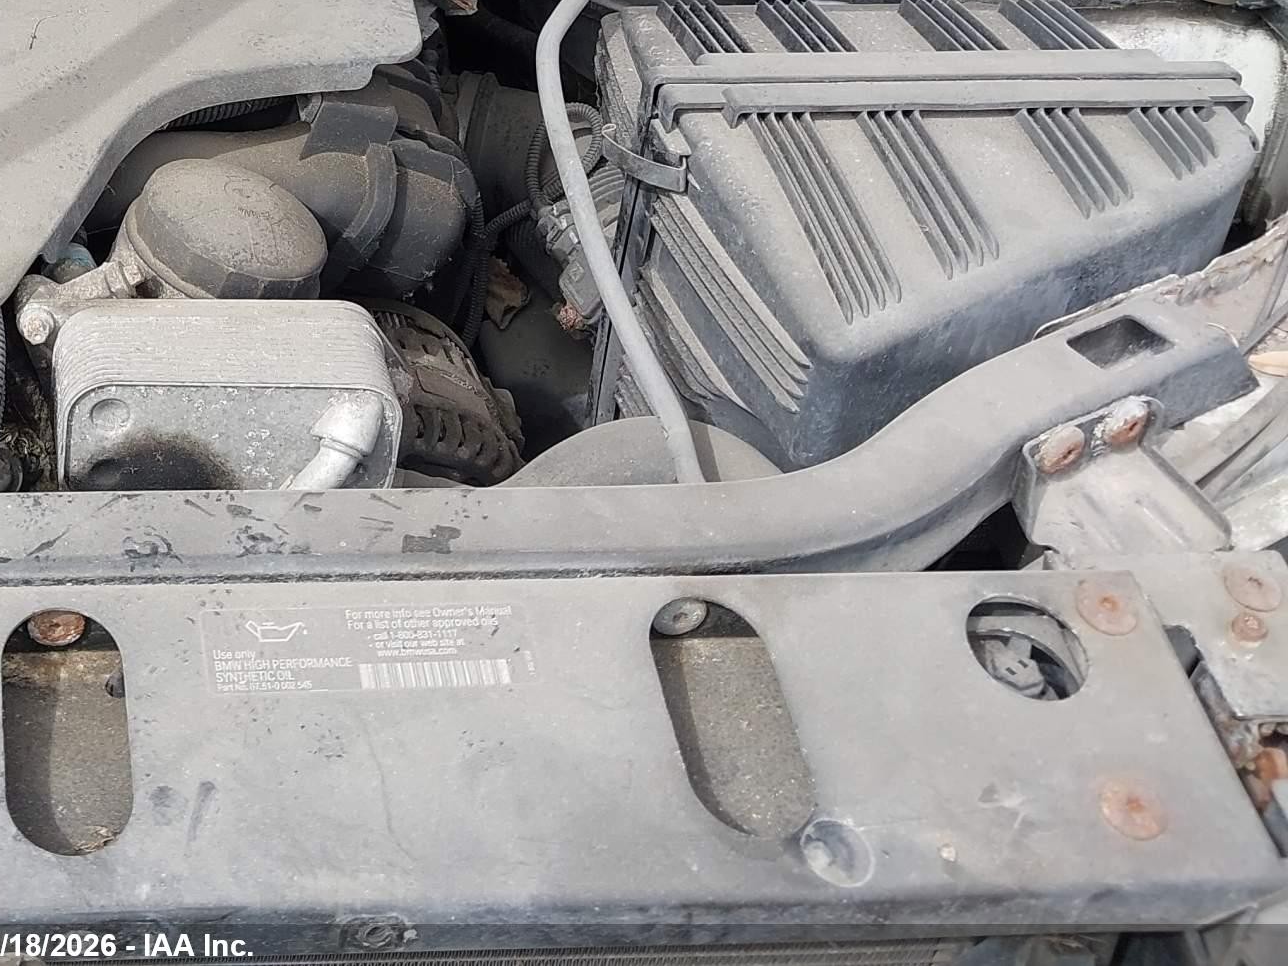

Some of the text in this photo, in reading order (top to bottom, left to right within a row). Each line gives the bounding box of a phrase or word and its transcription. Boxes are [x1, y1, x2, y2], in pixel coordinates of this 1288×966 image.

[345, 609, 362, 619] For
[364, 610, 391, 619] more
[347, 620, 364, 630] For
[391, 619, 401, 629] of
[213, 649, 255, 661] Use only
[214, 656, 353, 672] BMW HIGH PERFORMANCE
[215, 669, 295, 683] SYNTHETIC OIL
